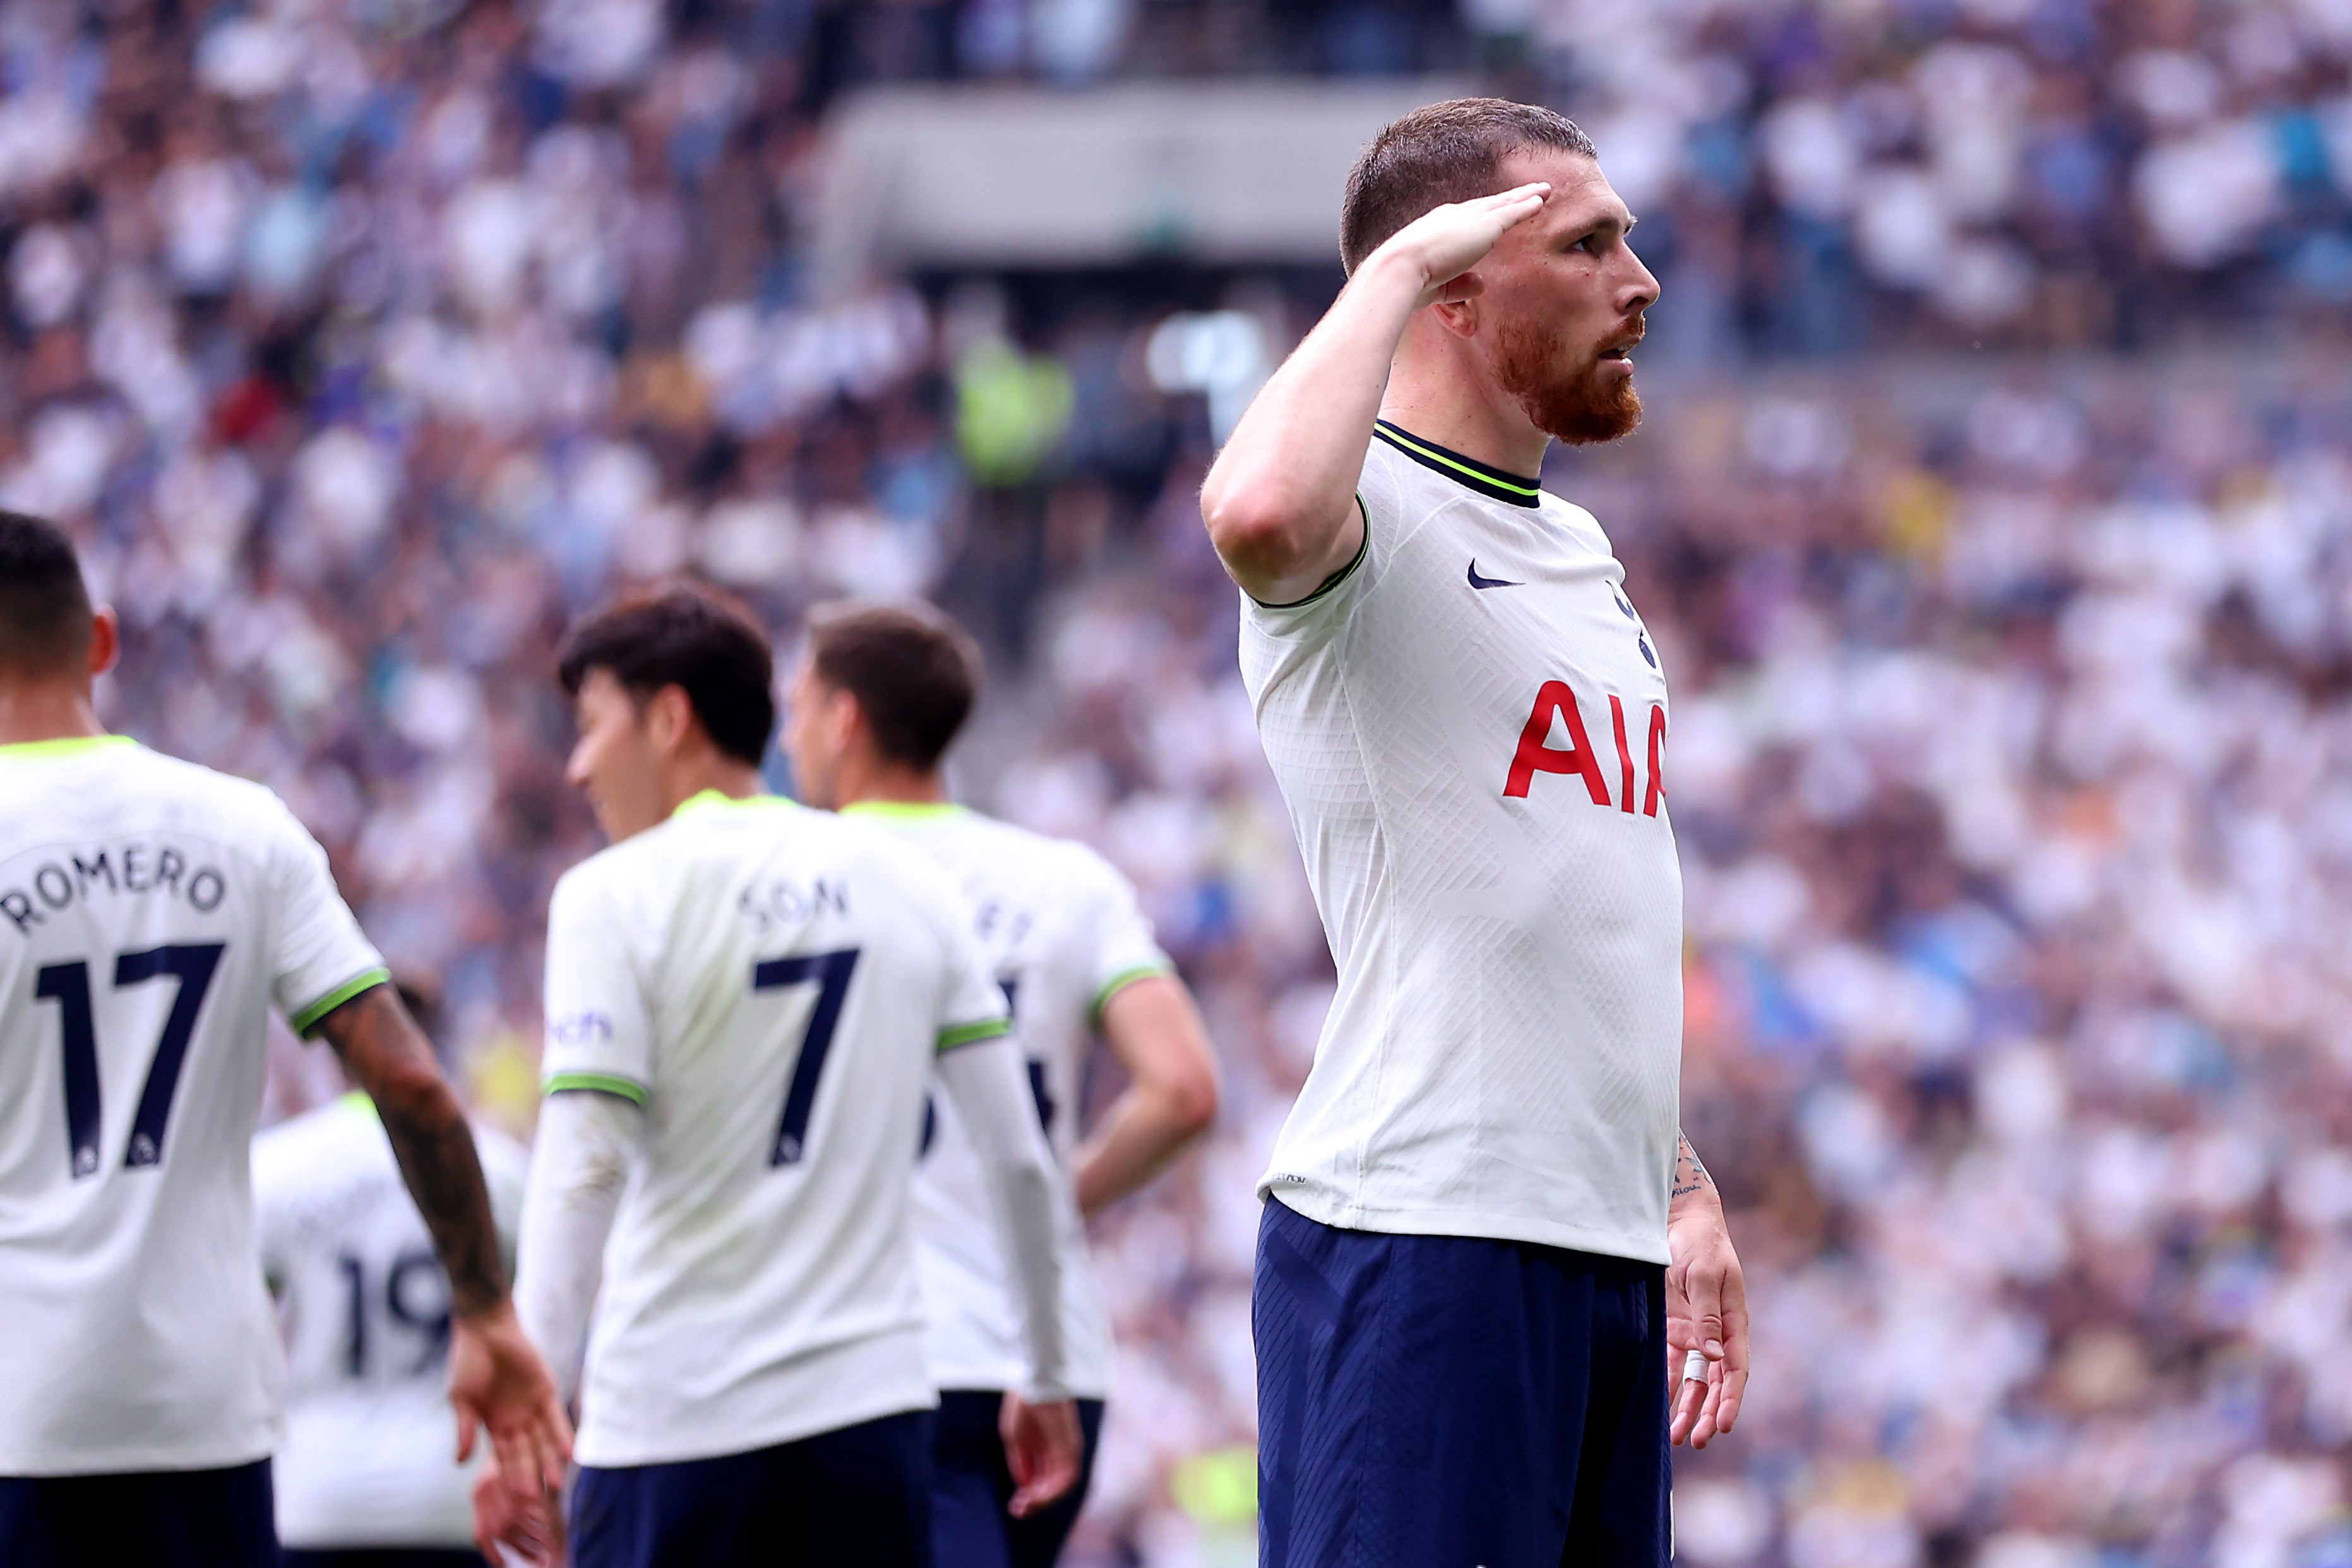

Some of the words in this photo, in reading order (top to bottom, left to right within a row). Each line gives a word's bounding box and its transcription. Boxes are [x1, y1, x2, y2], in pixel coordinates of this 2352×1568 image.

[0, 844, 225, 937] ROMERO
[737, 879, 848, 932] SON
[34, 941, 227, 1182] 17
[753, 947, 861, 1168] 7
[336, 1249, 453, 1377] 19
